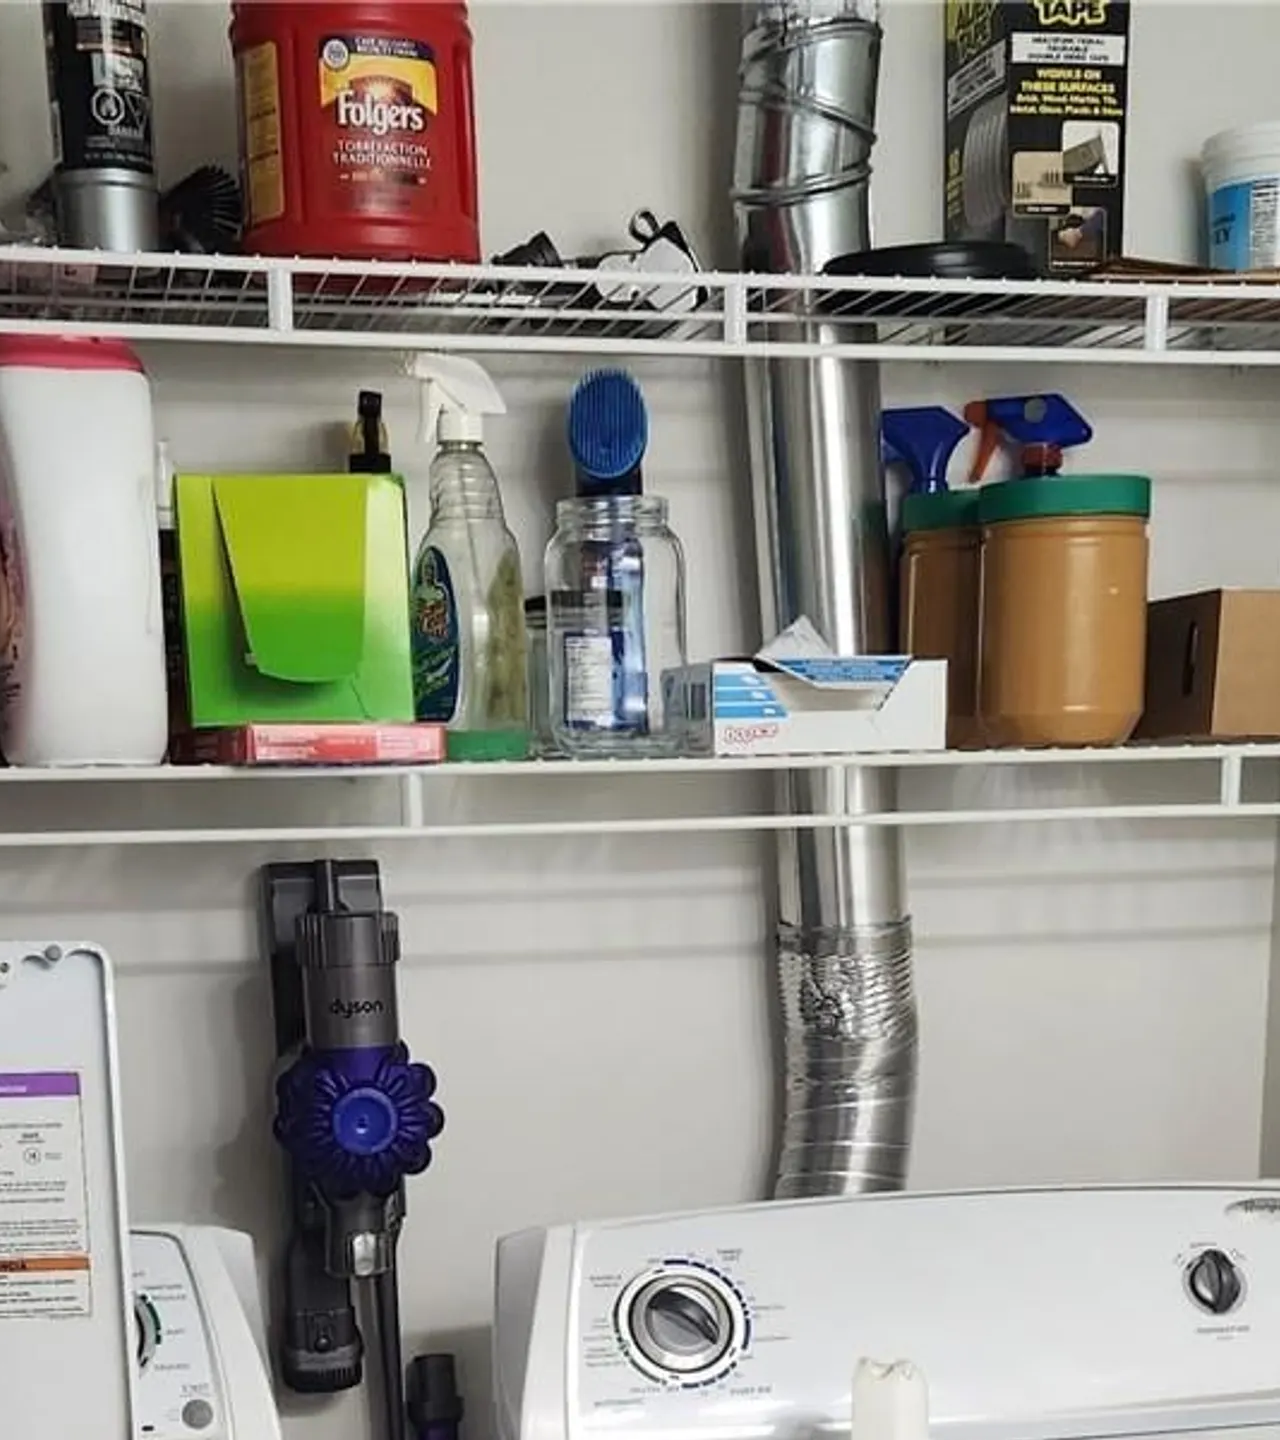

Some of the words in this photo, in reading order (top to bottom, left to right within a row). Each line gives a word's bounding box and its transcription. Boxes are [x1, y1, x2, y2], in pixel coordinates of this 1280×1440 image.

[1041, 0, 1105, 22] TAPE
[1036, 69, 1082, 80] WORKS
[1084, 69, 1102, 80] ON
[1022, 81, 1057, 92] THESE
[1058, 82, 1115, 93] SURFACES
[337, 89, 425, 136] Folgers
[329, 998, 384, 1019] dyson
